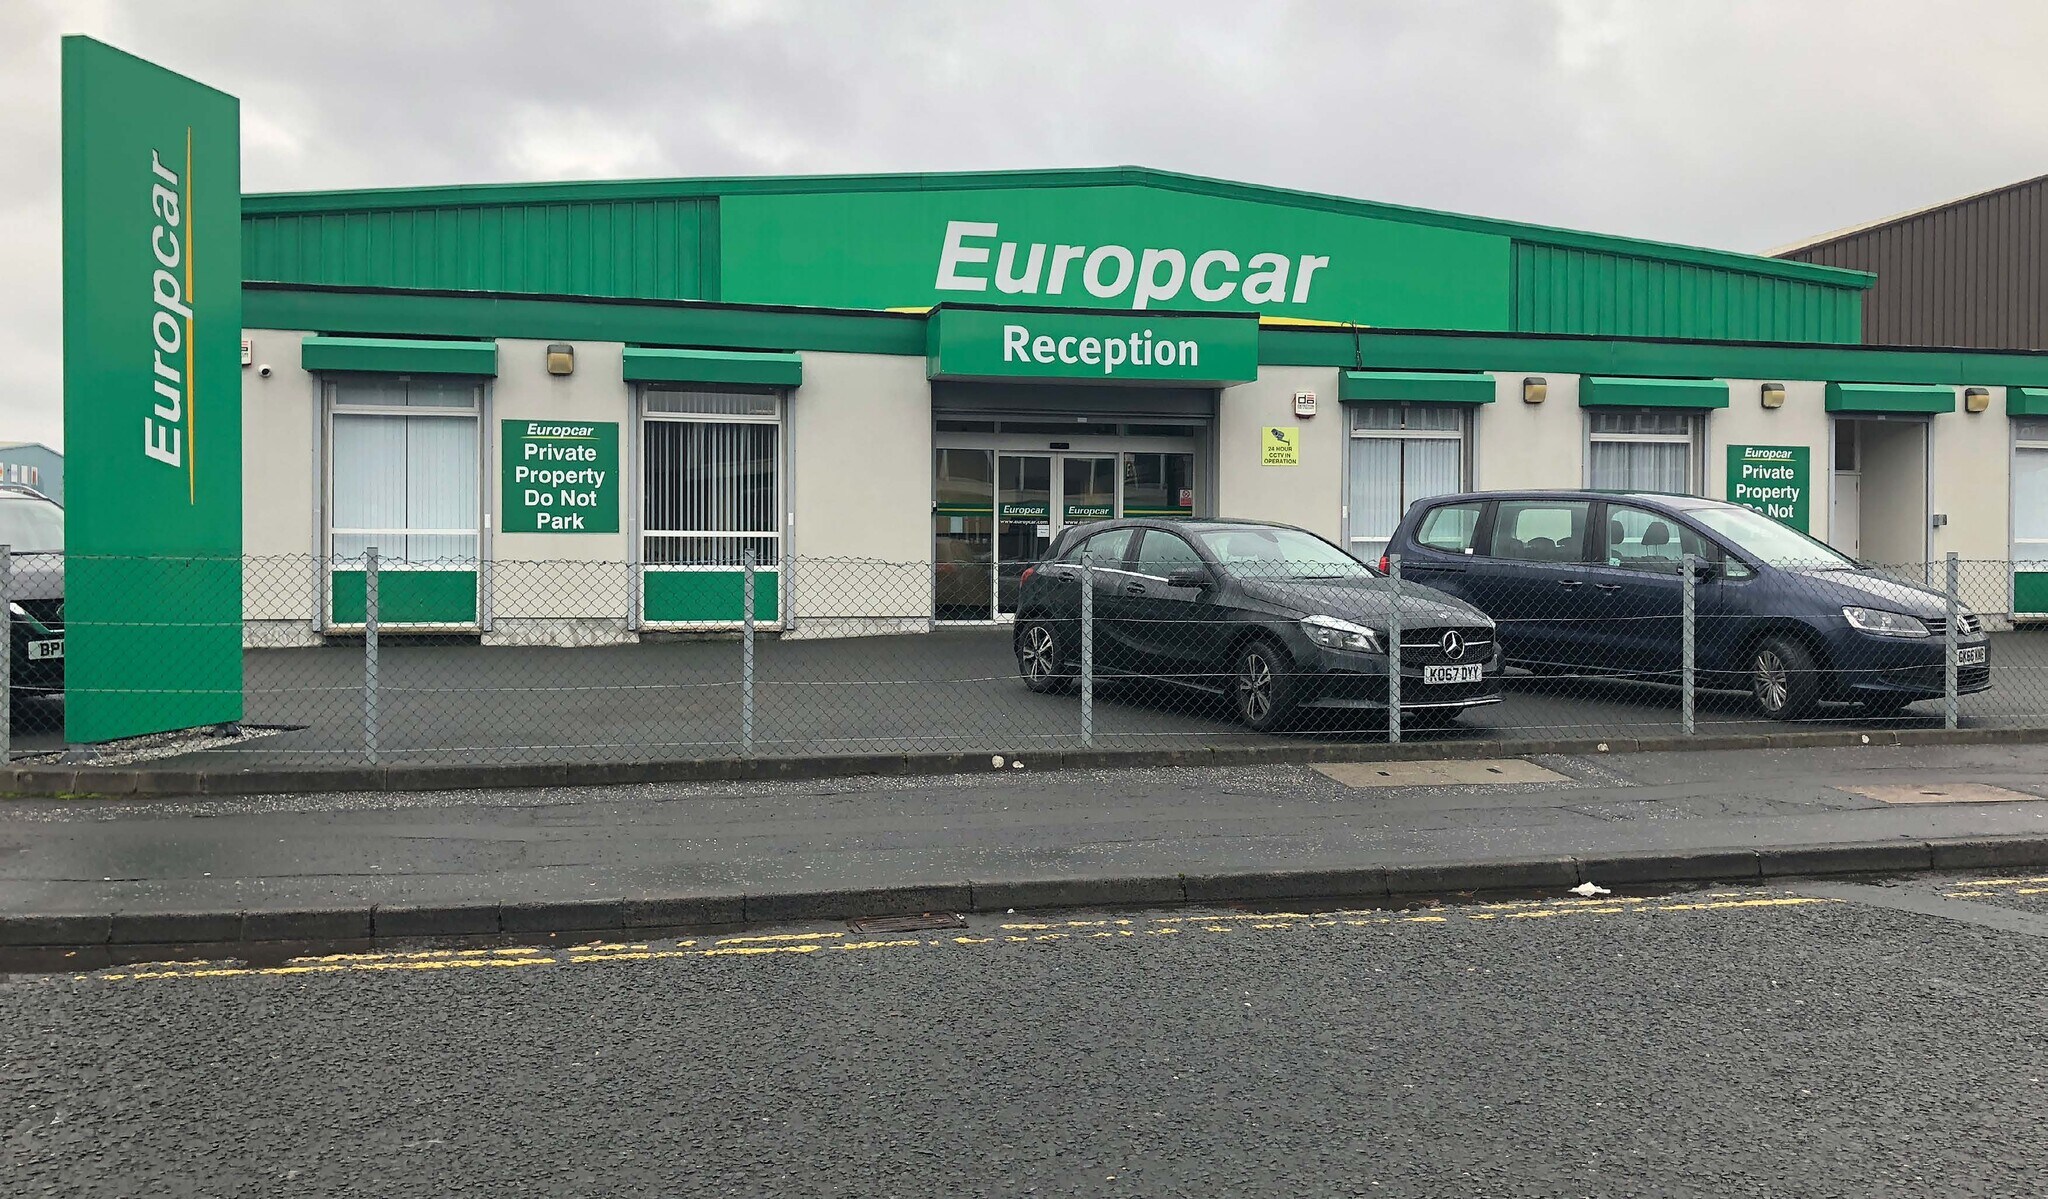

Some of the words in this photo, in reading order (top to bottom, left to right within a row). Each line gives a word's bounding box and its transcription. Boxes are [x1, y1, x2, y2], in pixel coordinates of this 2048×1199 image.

[934, 220, 1330, 310] Europcar
[145, 149, 193, 468] Europcar
[1003, 325, 1198, 374] Reception
[527, 423, 594, 438] Europcar
[524, 443, 597, 461] Private
[1745, 448, 1792, 460] Europcar
[515, 466, 605, 489] Property
[1742, 464, 1795, 480] Private
[524, 489, 554, 506] Do
[560, 489, 597, 507] Not
[1736, 484, 1799, 502] Property
[1003, 505, 1045, 516] Europcar
[1068, 505, 1110, 516] Europcar
[1767, 503, 1794, 518] Not
[537, 512, 585, 530] Park
[1461, 666, 1479, 680] DYY
